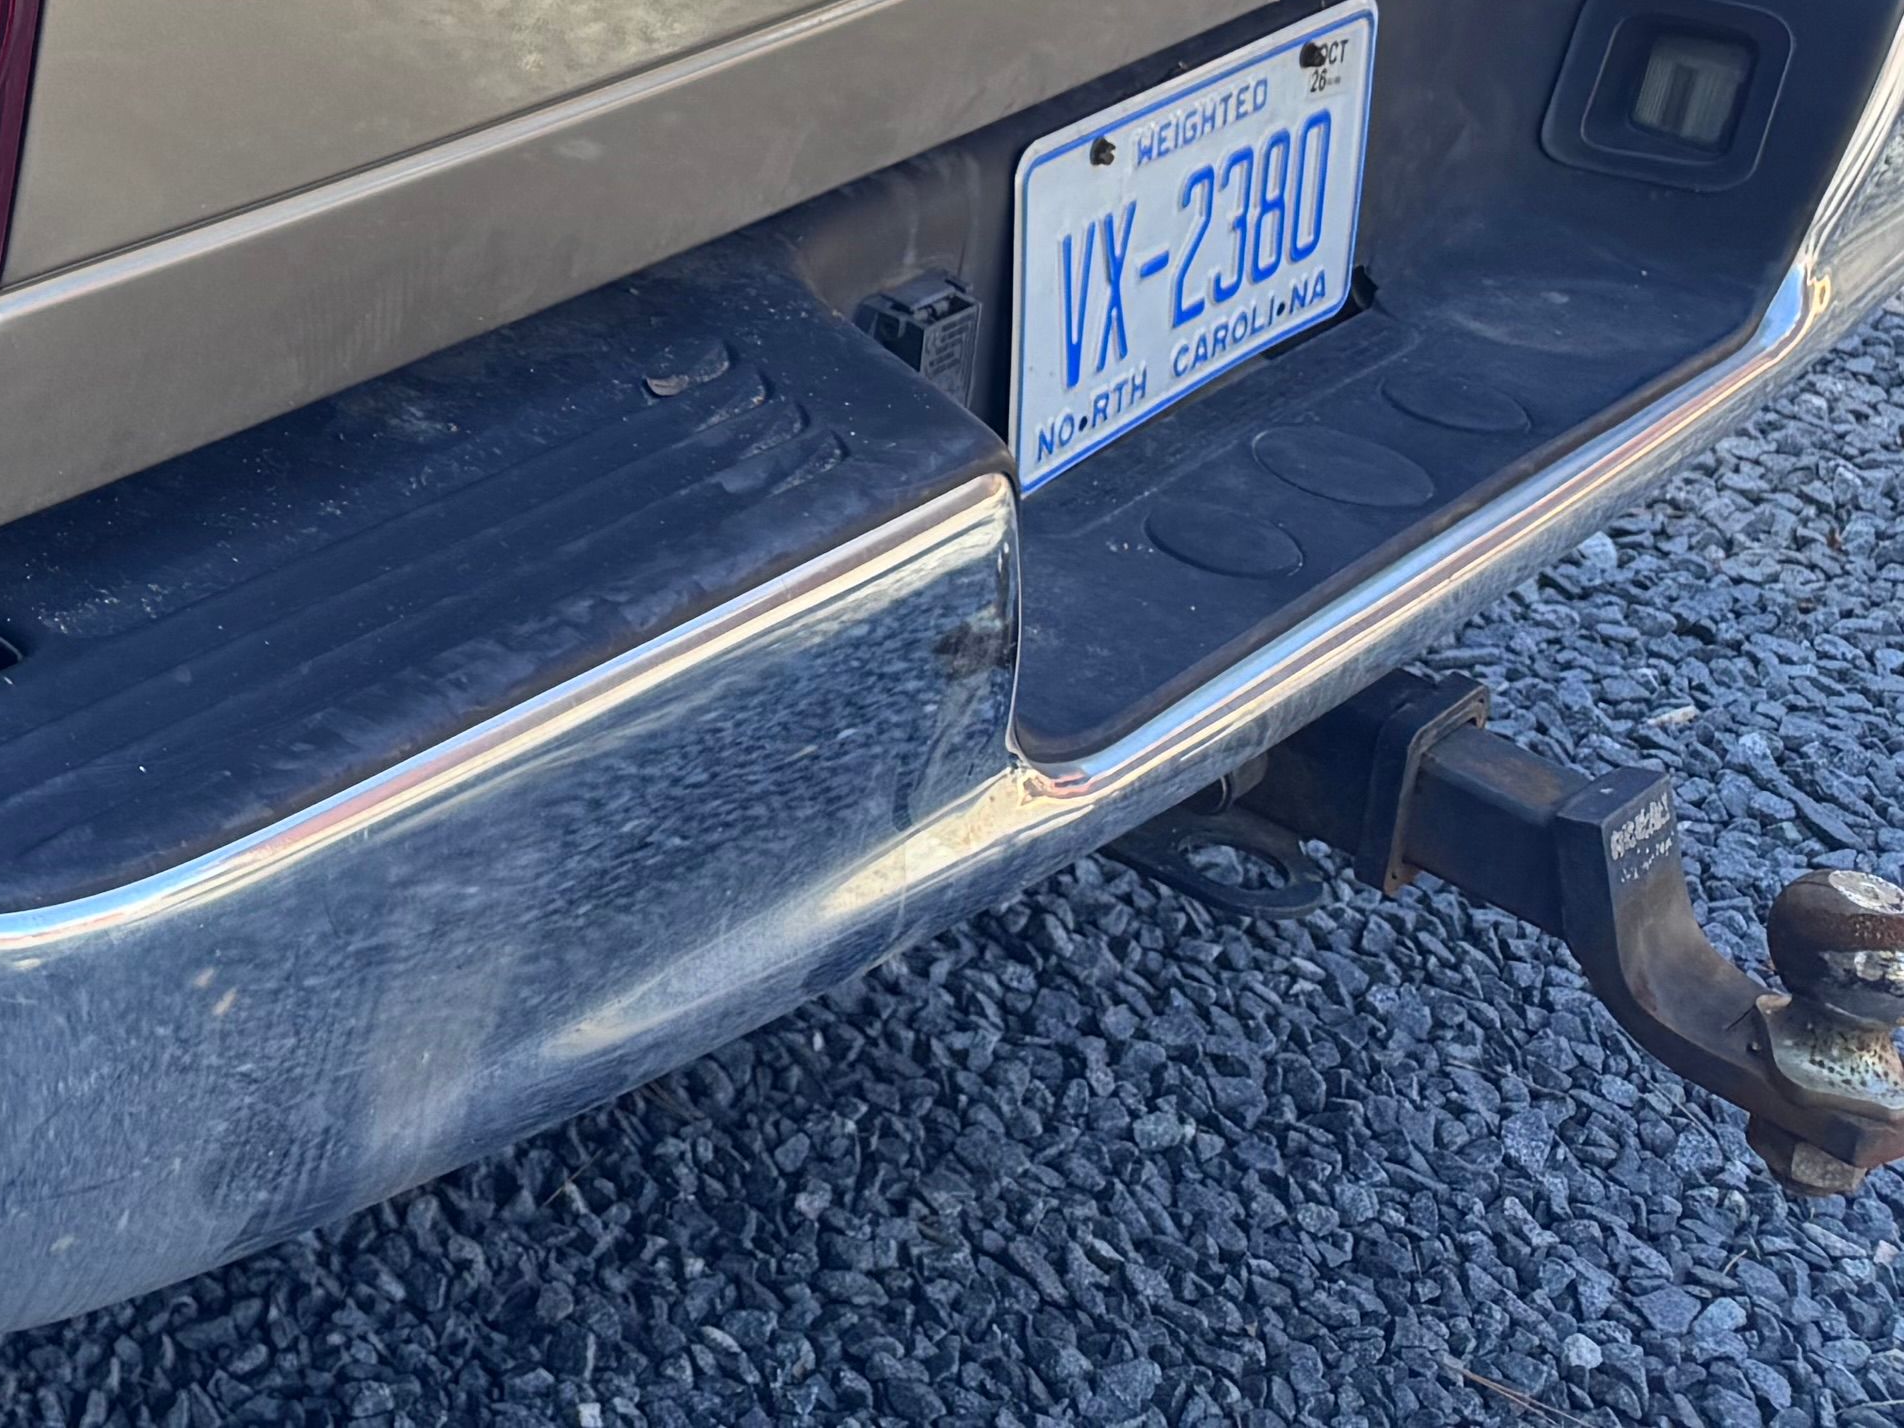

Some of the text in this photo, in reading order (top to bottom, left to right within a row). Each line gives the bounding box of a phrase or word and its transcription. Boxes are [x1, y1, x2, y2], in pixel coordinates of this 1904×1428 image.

[1136, 77, 1268, 166] WEIGHTED
[1309, 67, 1328, 93] 26
[1059, 107, 1332, 389] VX-2380
[1036, 269, 1326, 462] NORTH CAROLINA
